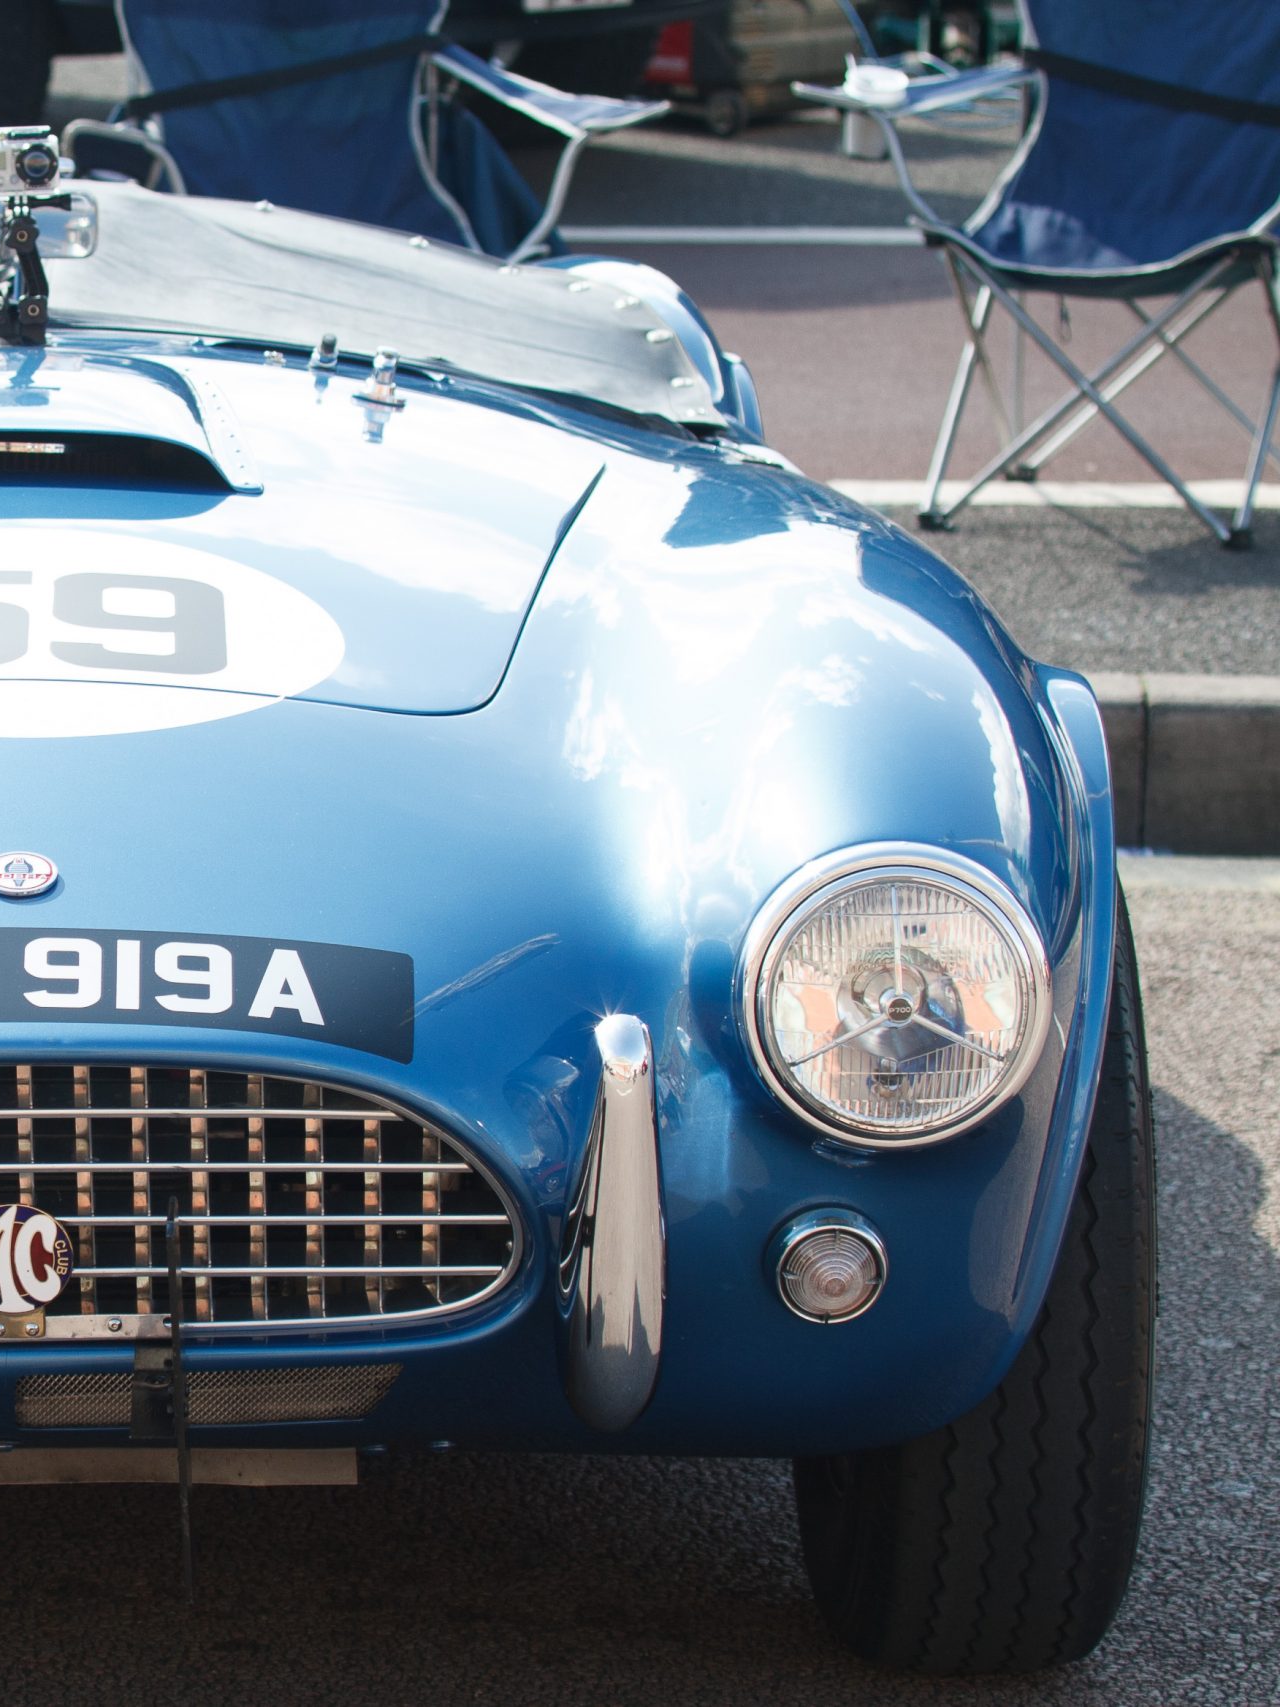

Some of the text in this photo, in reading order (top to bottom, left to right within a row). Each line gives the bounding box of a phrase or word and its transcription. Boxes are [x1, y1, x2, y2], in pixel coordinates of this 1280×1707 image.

[23, 937, 325, 1026] 919A
[888, 1006, 911, 1014] P700
[54, 1240, 69, 1276] CLUB
